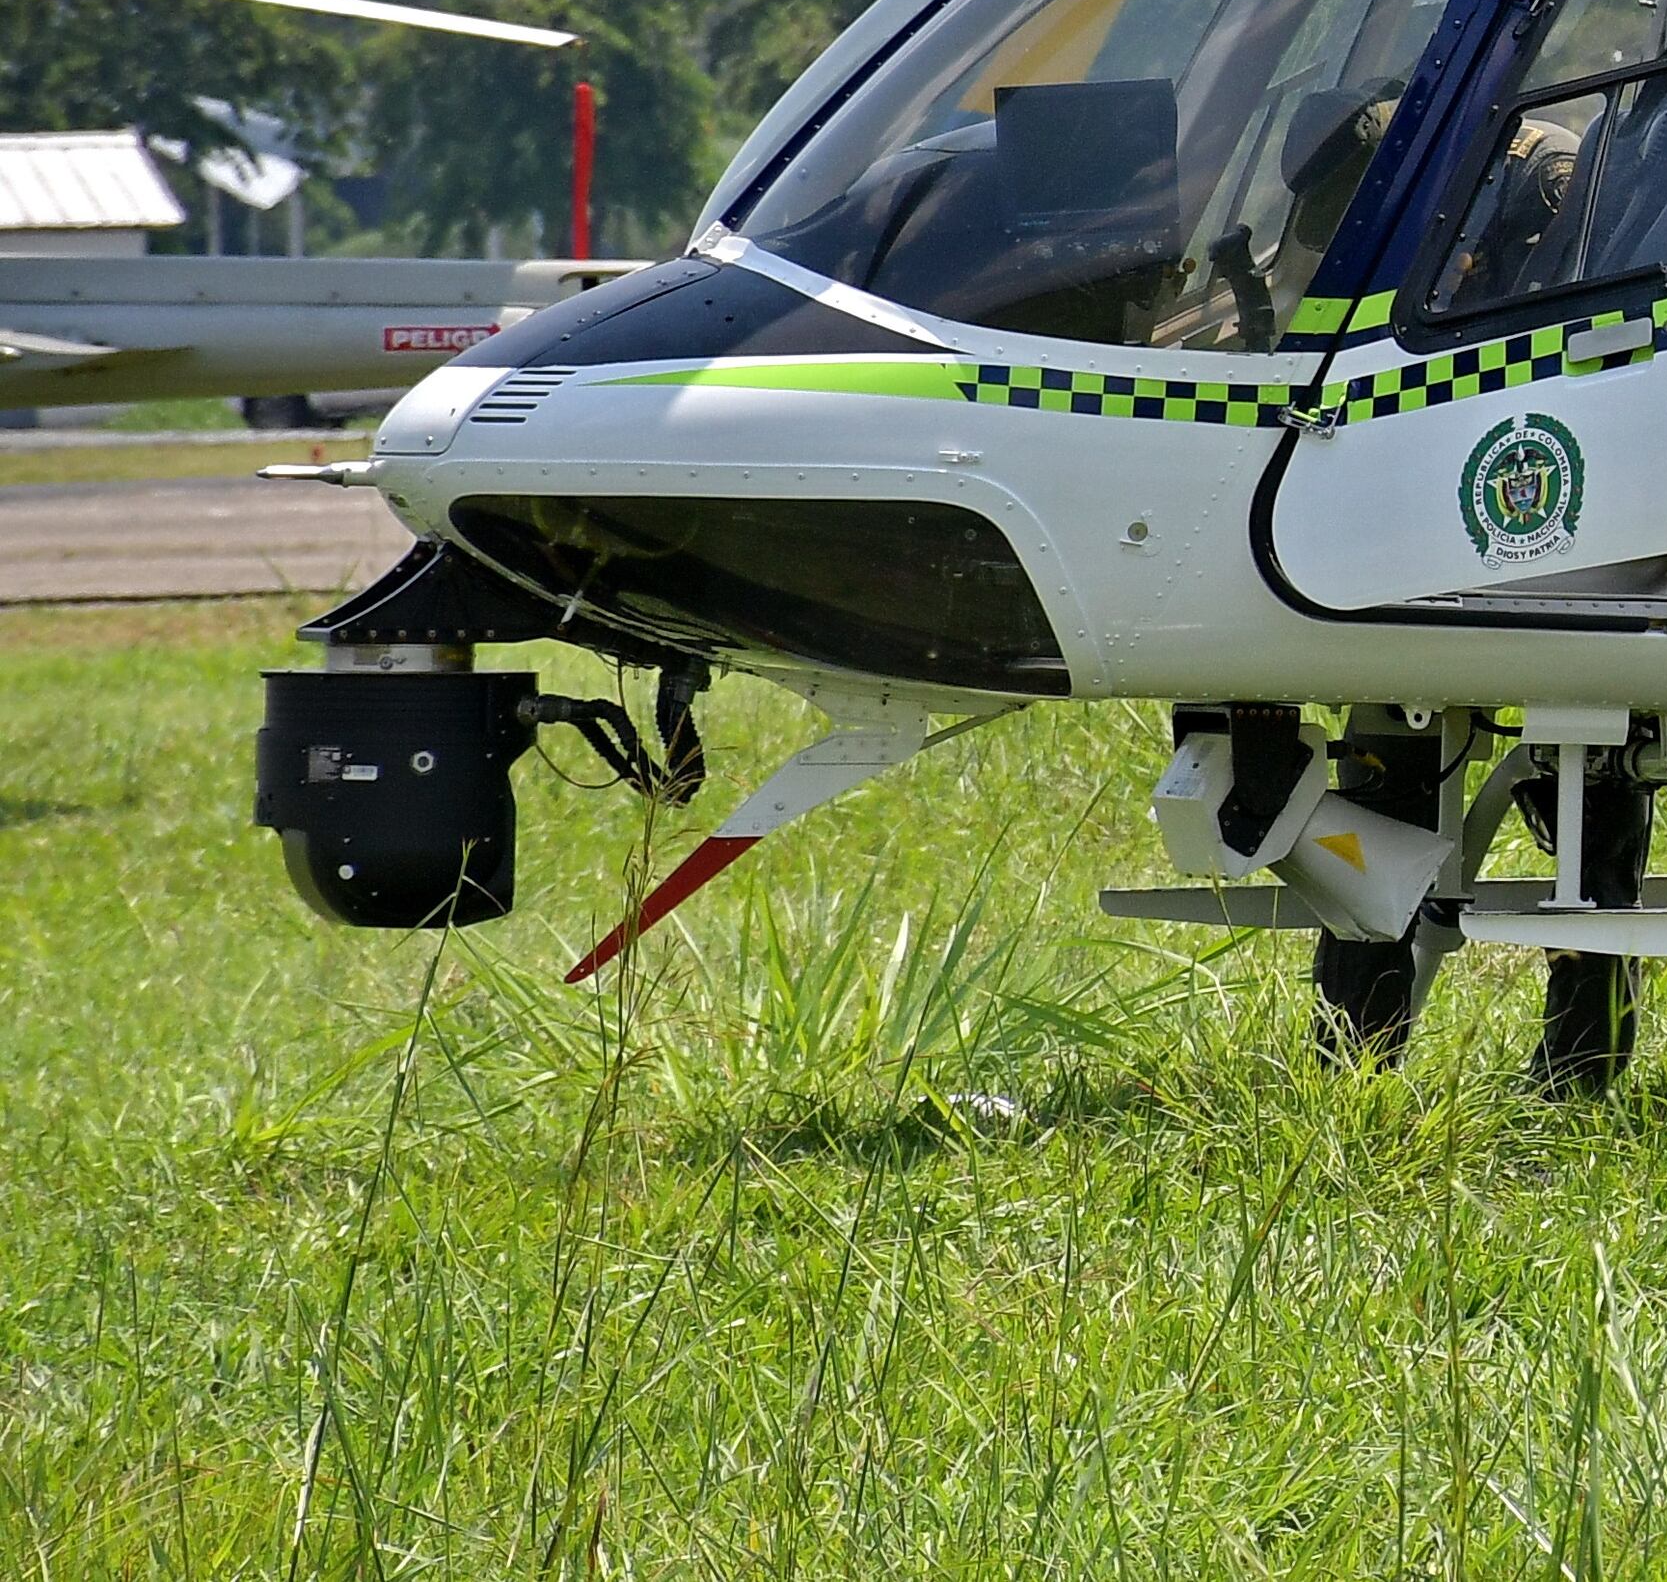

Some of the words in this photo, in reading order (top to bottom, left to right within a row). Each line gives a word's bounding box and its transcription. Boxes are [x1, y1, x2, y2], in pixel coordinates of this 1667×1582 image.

[1515, 430, 1528, 440] DE
[1538, 433, 1569, 486] COLOMBIA
[1528, 500, 1567, 543] NACIONAL
[1495, 547, 1520, 560] DIOS
[1529, 535, 1560, 557] PATRIA
